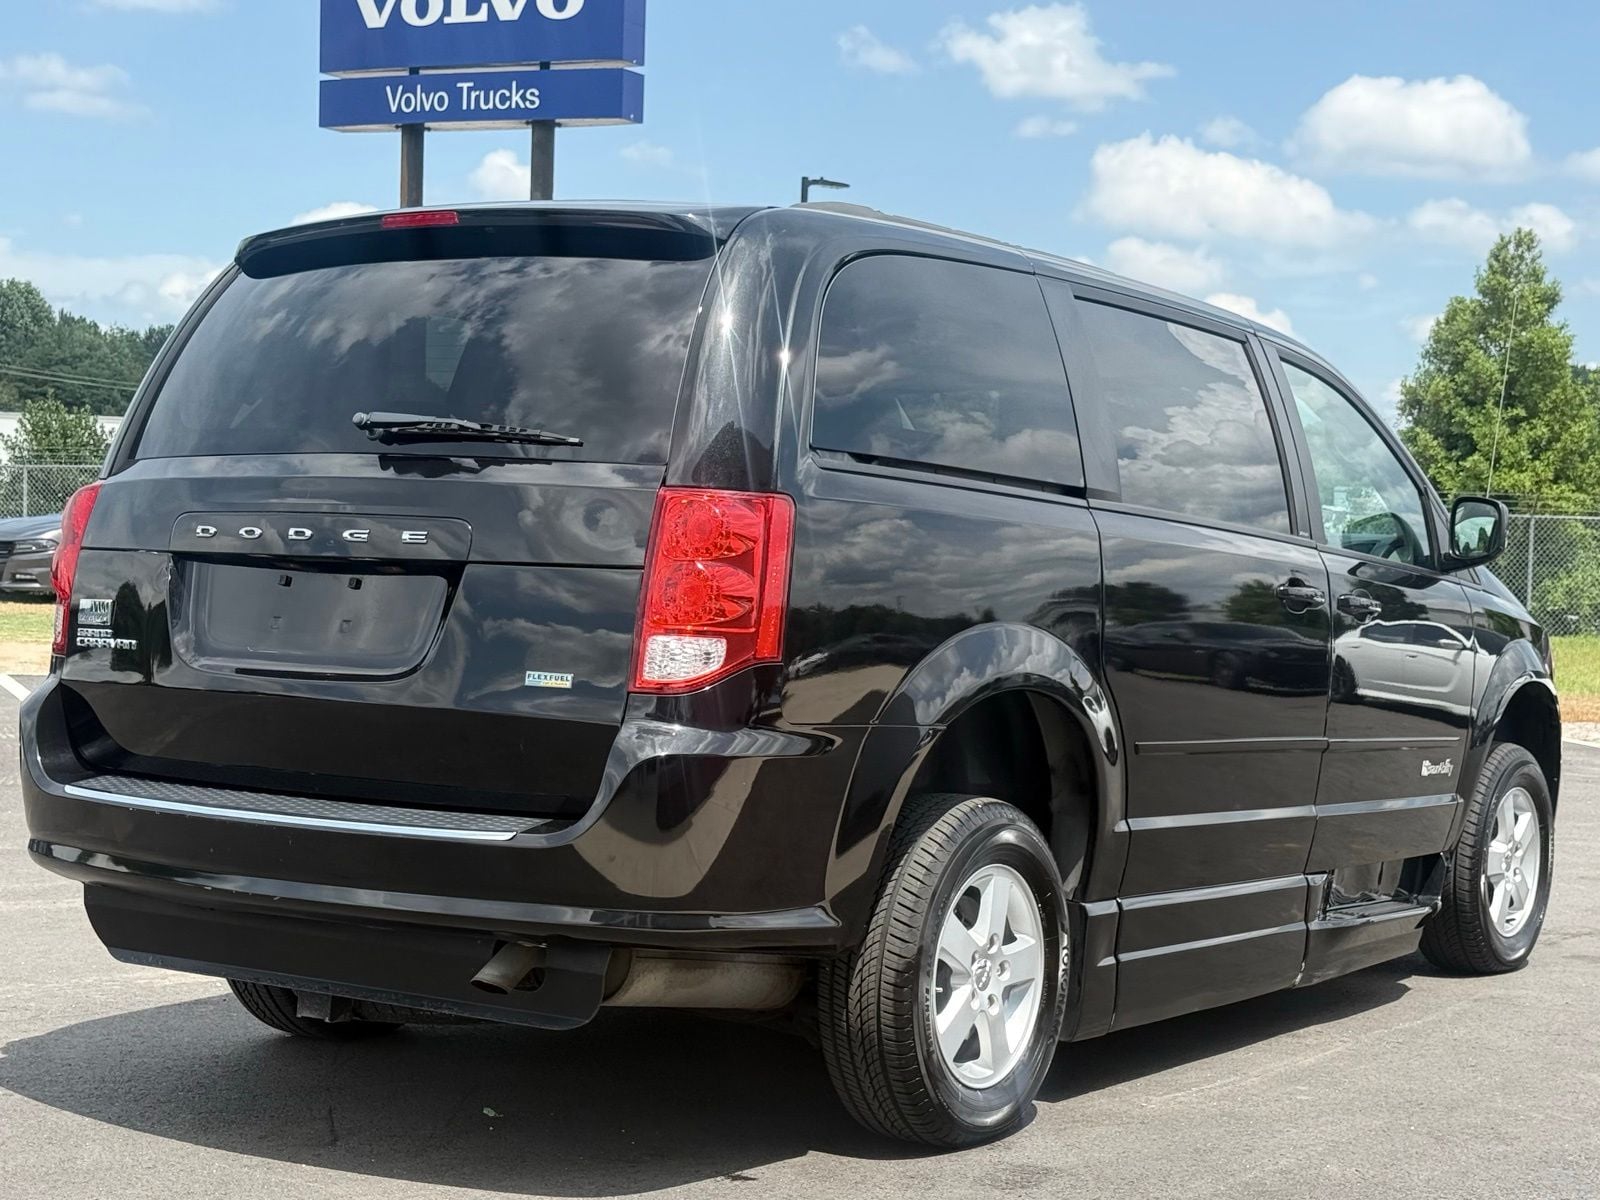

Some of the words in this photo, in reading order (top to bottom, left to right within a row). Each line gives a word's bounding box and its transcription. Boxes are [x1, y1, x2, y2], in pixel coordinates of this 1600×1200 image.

[356, 0, 585, 28] VOLVO
[386, 83, 449, 113] Volvo
[456, 80, 541, 111] Trucks
[195, 524, 430, 544] DODGE
[527, 673, 570, 682] FLEXFUEL
